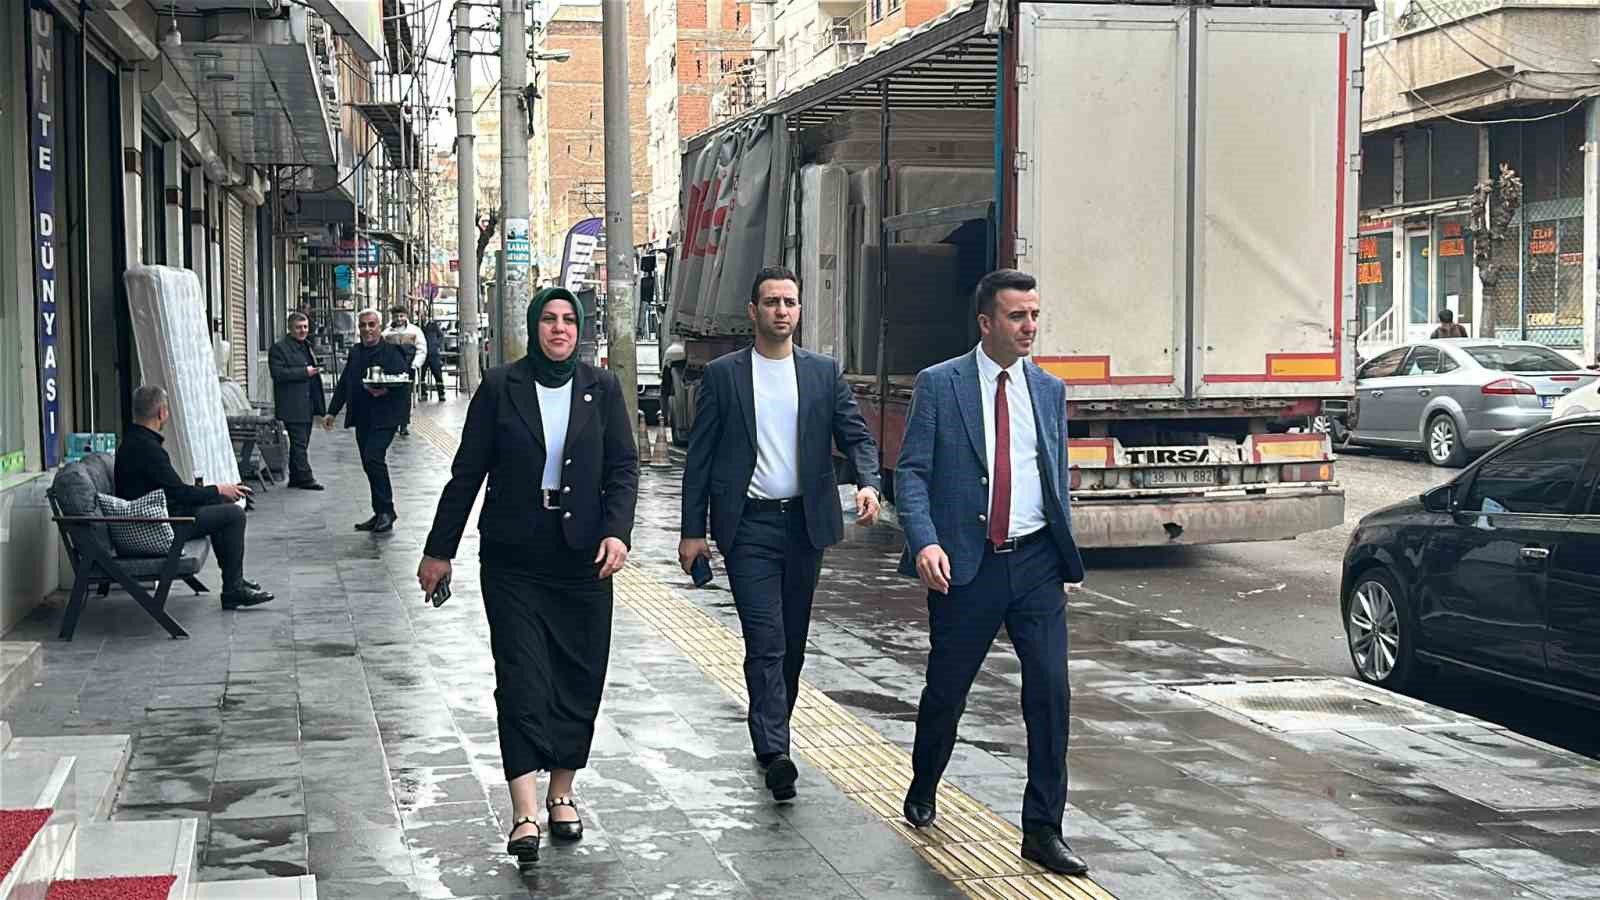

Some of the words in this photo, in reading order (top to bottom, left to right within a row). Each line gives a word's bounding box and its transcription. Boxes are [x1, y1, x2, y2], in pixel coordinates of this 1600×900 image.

[39, 212, 57, 435] DÜNYASI
[1152, 470, 1165, 482] 38
[1174, 470, 1188, 482] YN
